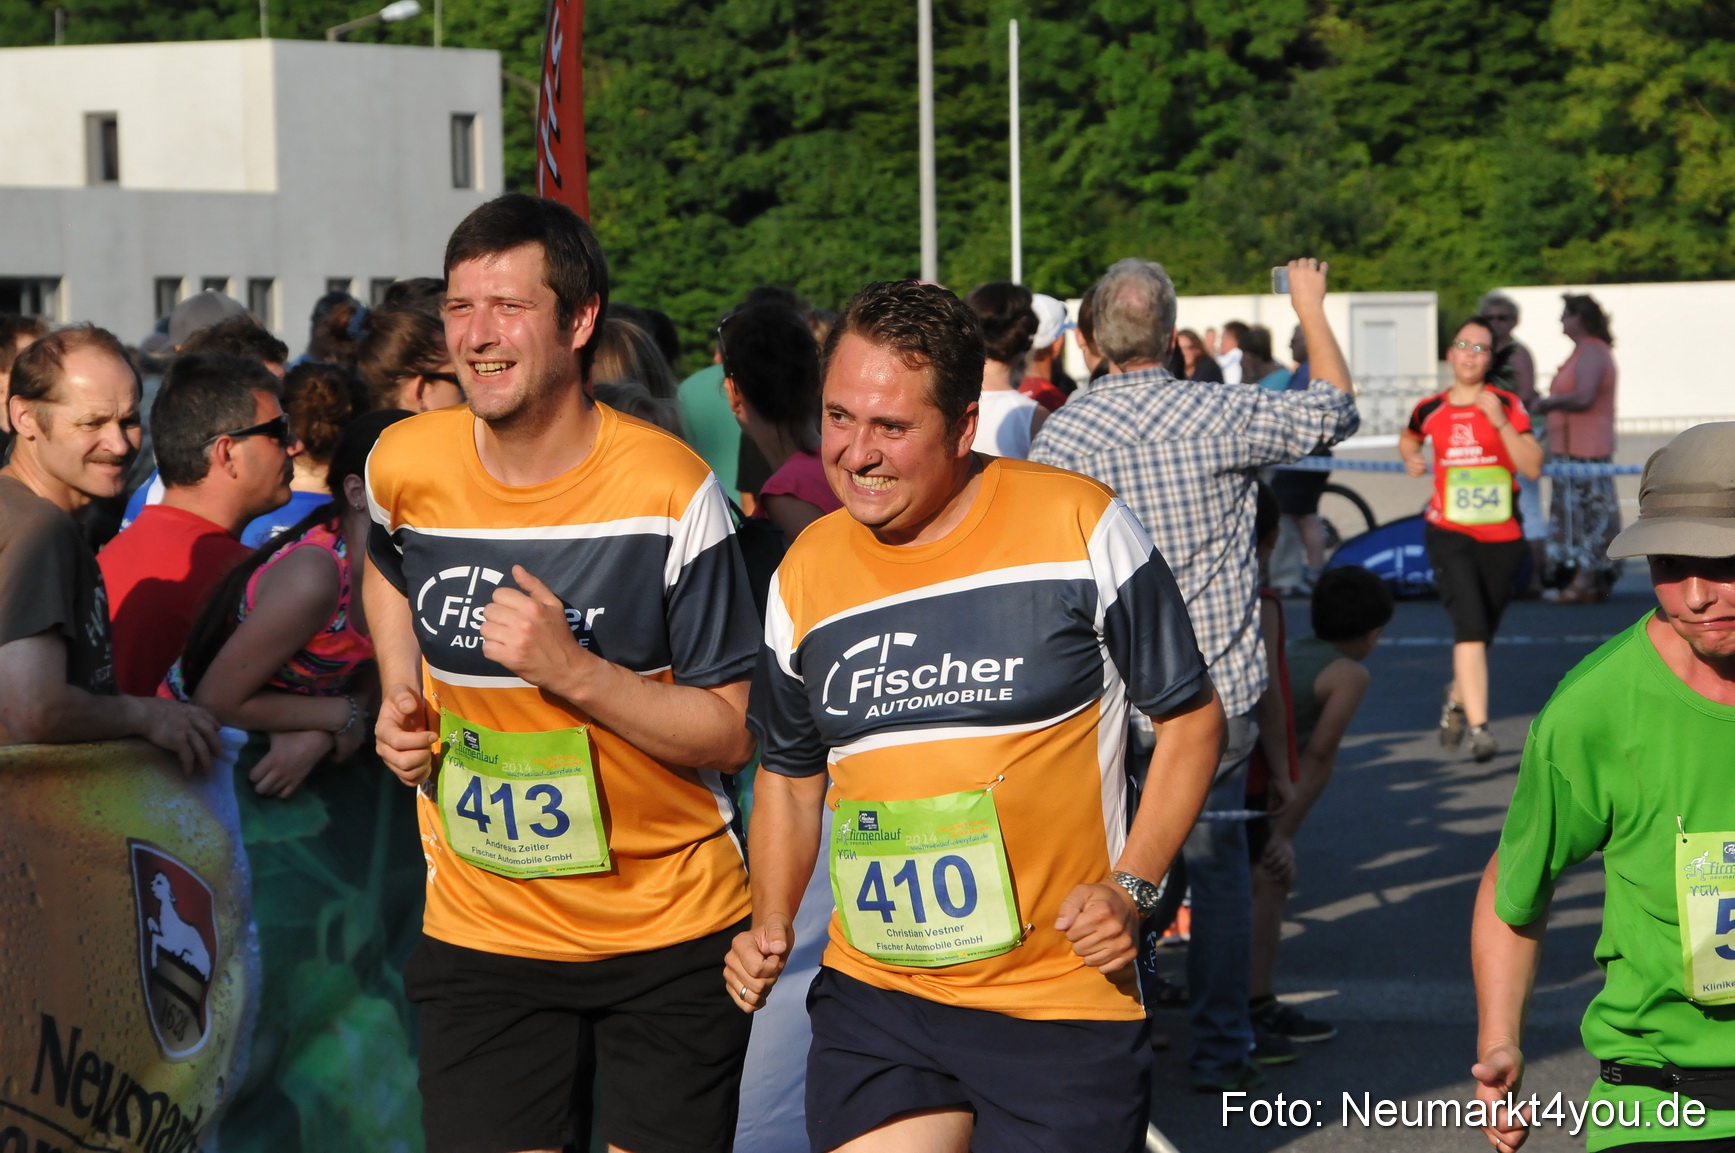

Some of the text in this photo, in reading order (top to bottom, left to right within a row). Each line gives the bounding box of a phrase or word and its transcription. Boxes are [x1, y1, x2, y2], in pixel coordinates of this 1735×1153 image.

[1456, 487, 1501, 509] 854
[439, 595, 605, 632] Fiser
[849, 653, 1024, 703] Fischer
[865, 687, 1013, 719] AUTOMOBILE
[458, 741, 499, 765] firmenlauf
[502, 761, 533, 774] 2014
[456, 776, 570, 840] 413
[486, 838, 550, 853] Andreas Zeitler
[849, 828, 902, 841] firmenlauf
[905, 832, 938, 847] 2014
[472, 846, 573, 865] Fischer Automobile GmbH
[856, 855, 978, 924] 410
[886, 924, 965, 938] Christian Vestner
[876, 935, 983, 951] Fischer Automobile GmbH
[161, 998, 189, 1042] 1628
